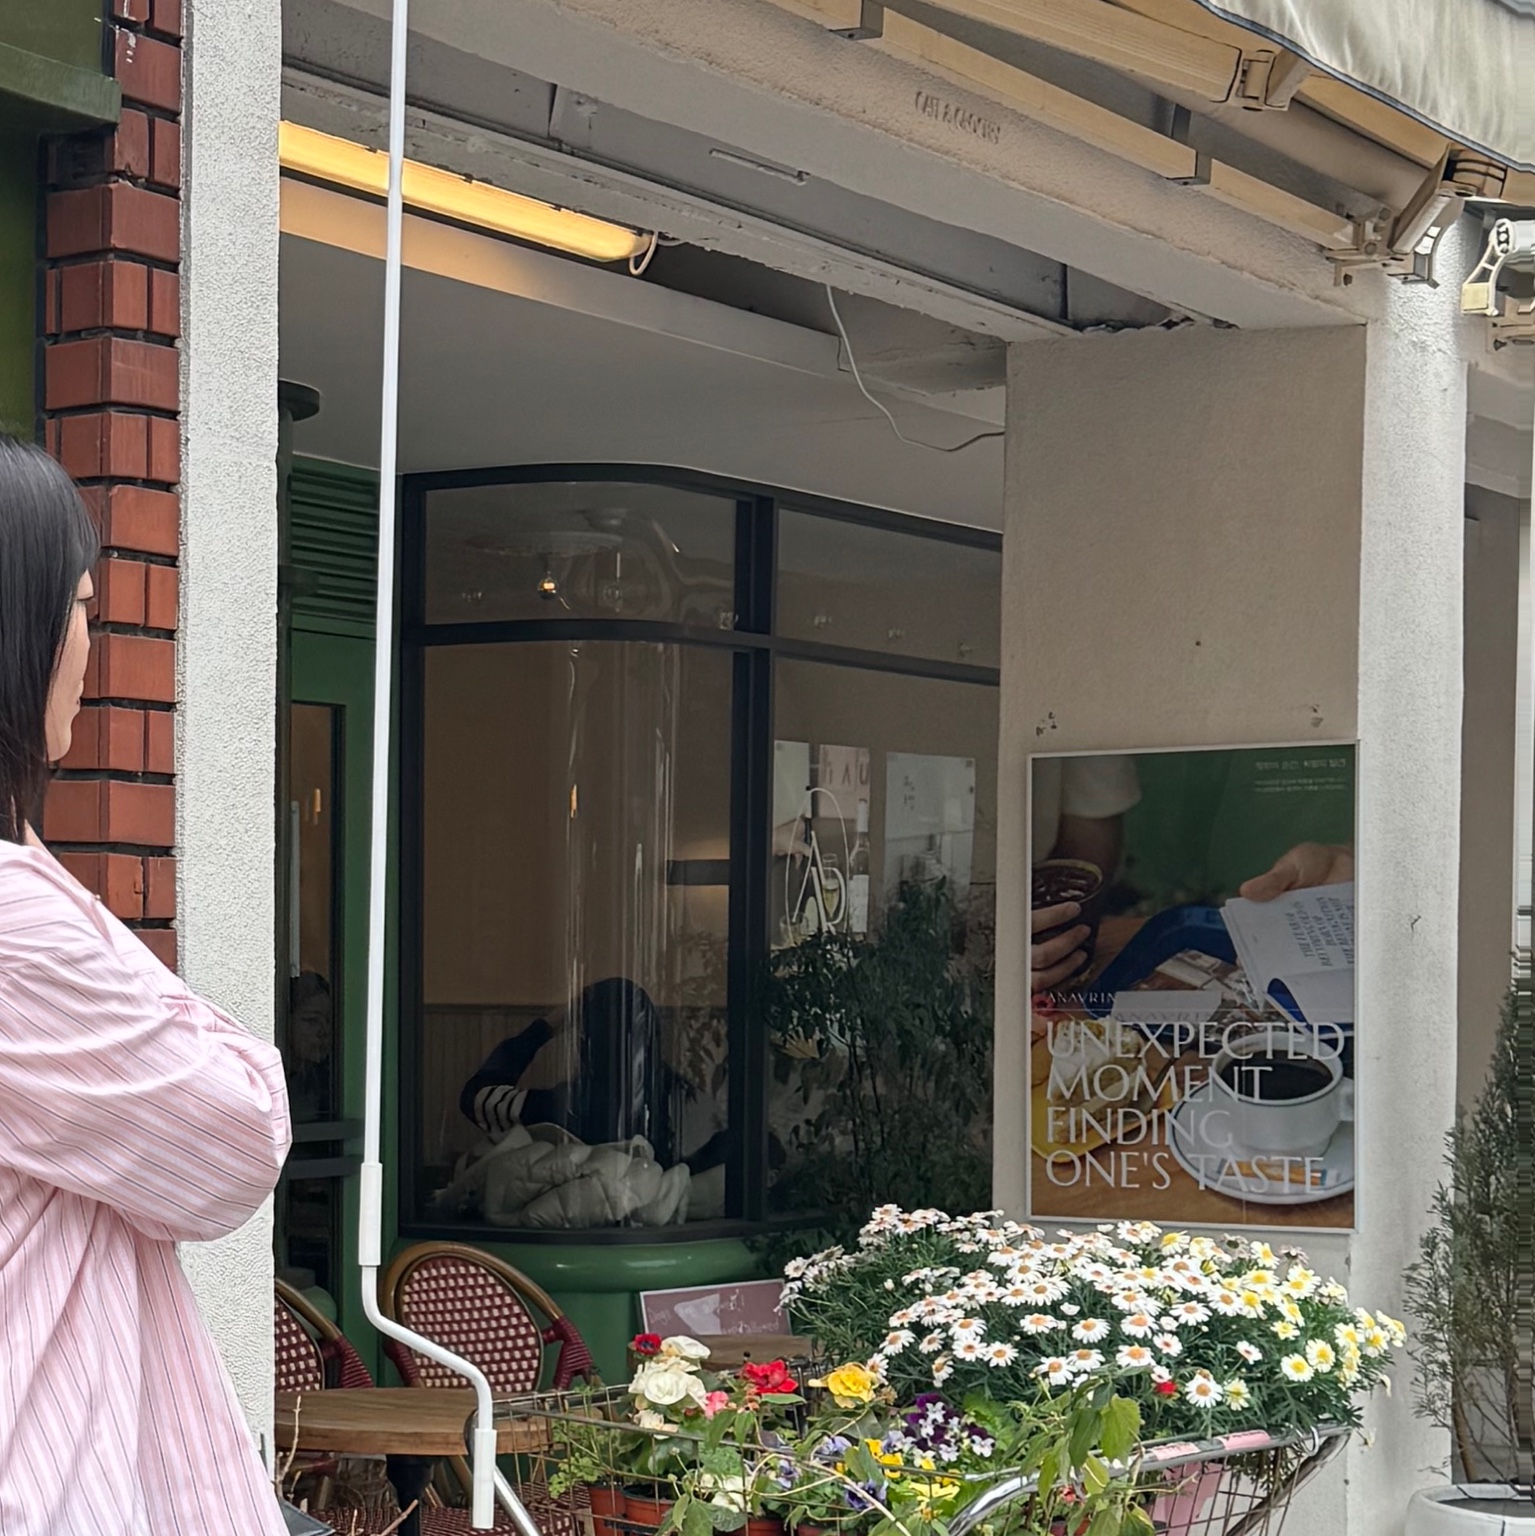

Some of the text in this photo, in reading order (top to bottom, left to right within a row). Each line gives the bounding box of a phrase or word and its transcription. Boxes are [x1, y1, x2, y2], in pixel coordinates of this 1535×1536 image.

[1049, 991, 1115, 1004] ANAVRIN
[1046, 1020, 1345, 1060] UNEXPECTED
[1046, 1064, 1273, 1102] MOMENT
[1046, 1106, 1233, 1149] FINDING
[1045, 1149, 1326, 1194] ONE'S TASTE
